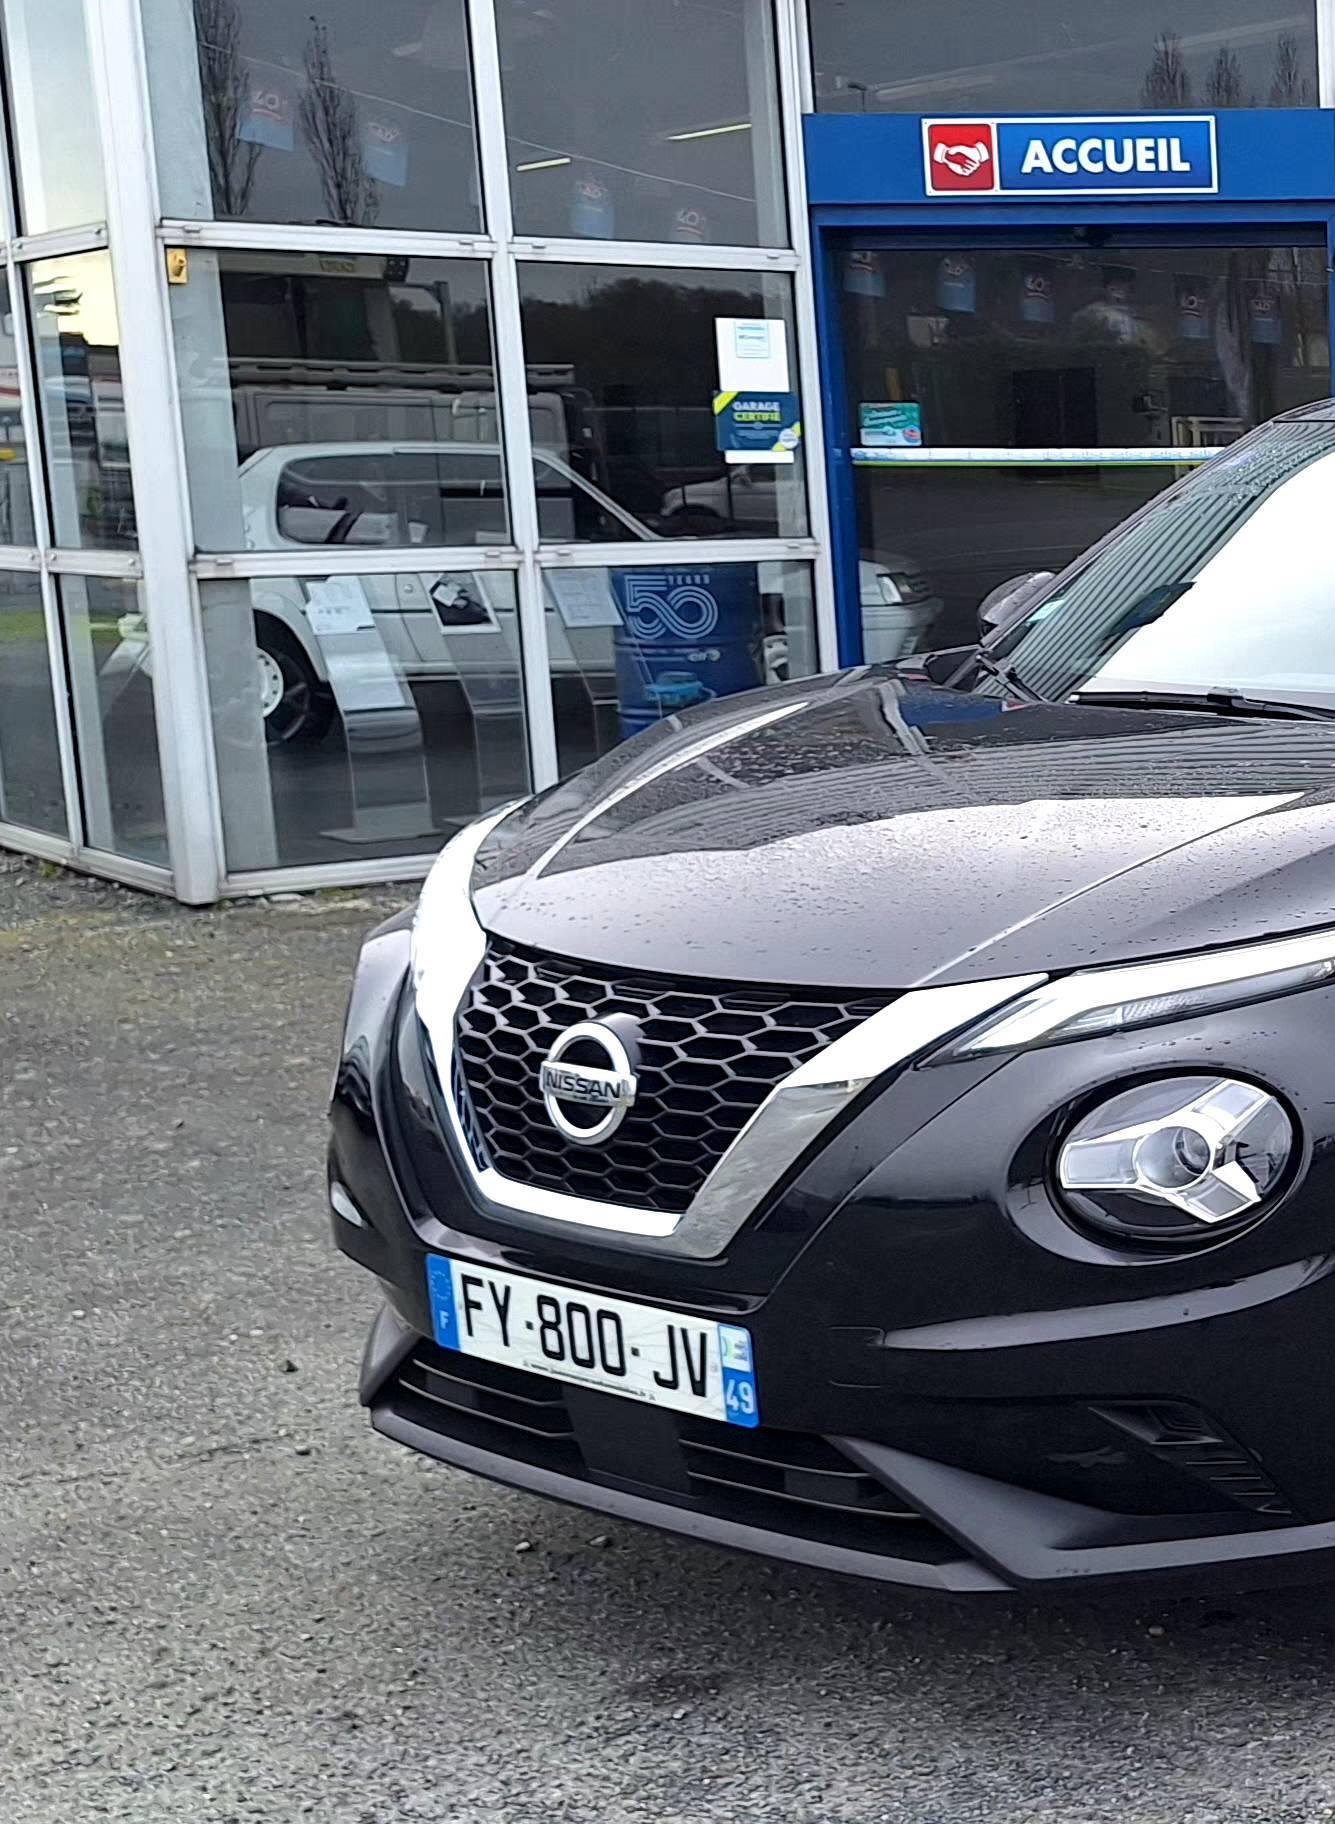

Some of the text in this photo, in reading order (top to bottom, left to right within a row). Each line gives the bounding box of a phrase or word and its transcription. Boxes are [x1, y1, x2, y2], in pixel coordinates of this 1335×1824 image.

[1020, 136, 1192, 175] ACCUEIL
[733, 401, 781, 412] GARAGE
[625, 574, 719, 640] 50
[546, 1070, 621, 1099] NISSAN
[439, 1311, 449, 1329] F
[726, 1378, 754, 1415] 49
